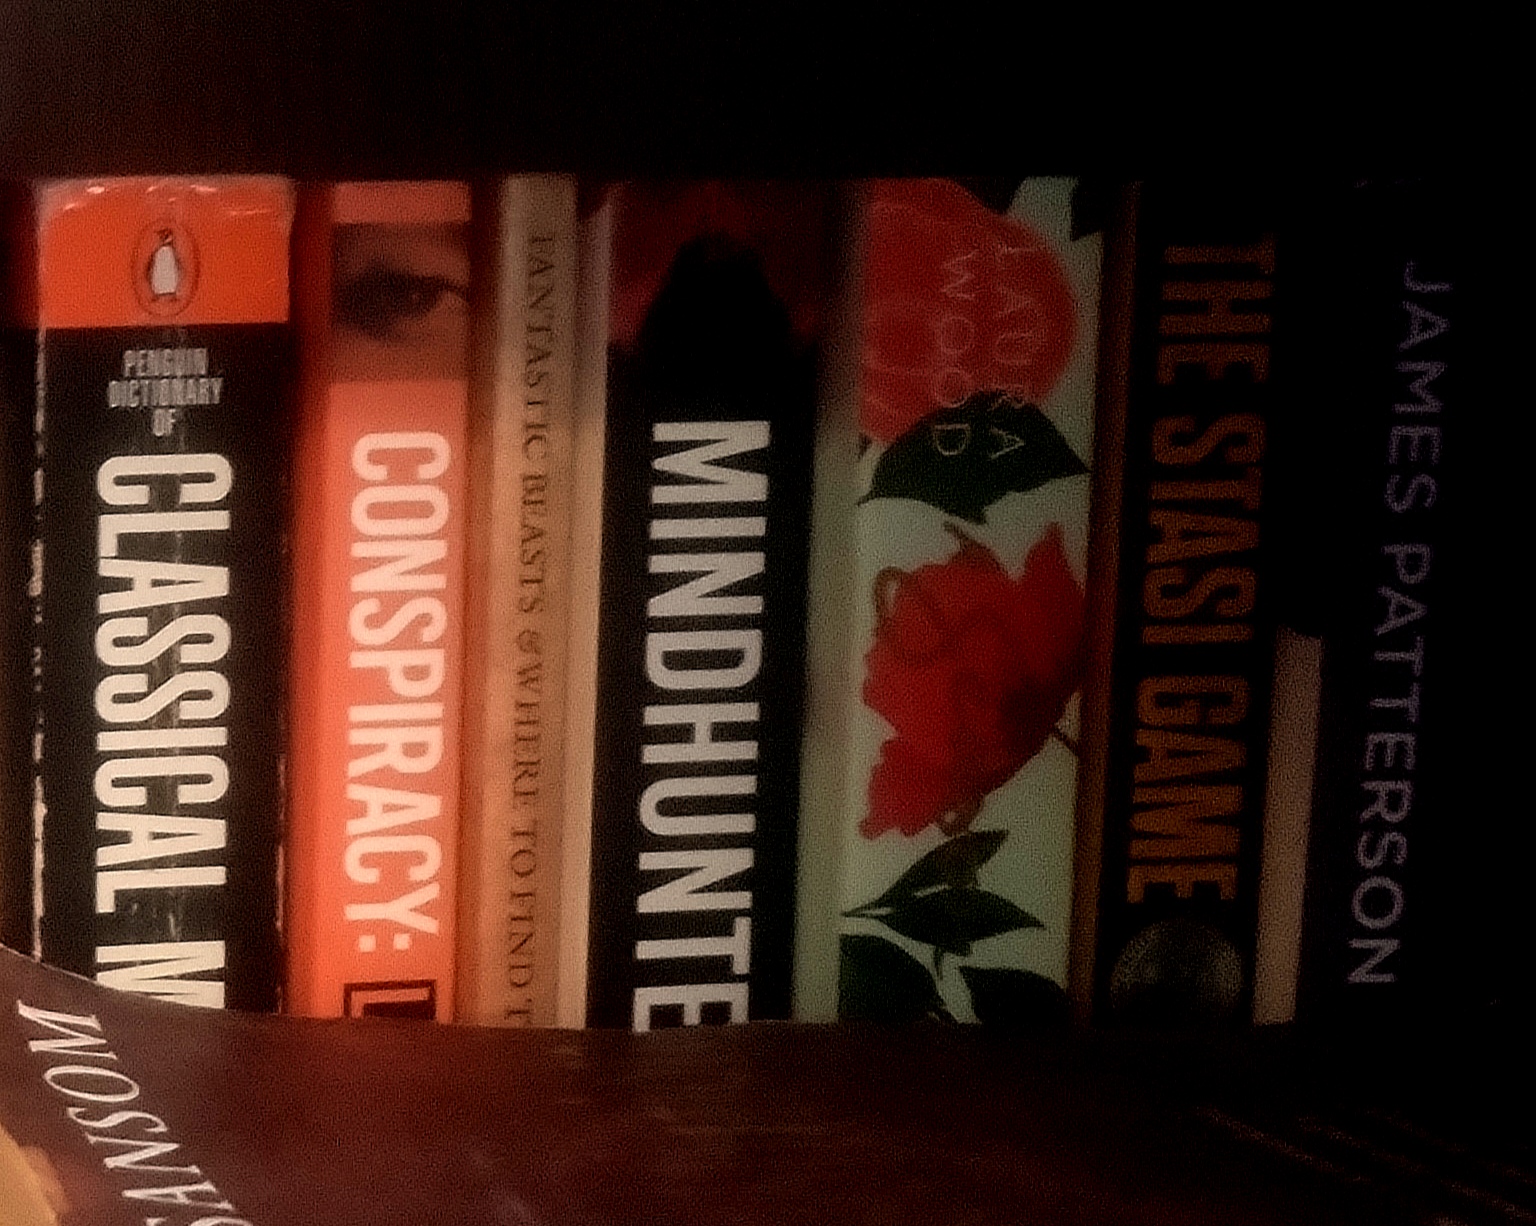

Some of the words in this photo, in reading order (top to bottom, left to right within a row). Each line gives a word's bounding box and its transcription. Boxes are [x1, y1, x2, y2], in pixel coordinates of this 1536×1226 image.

[521, 233, 557, 459] FANTASTIC
[931, 252, 976, 458] WOOD
[987, 245, 1042, 462] LAURA
[1155, 232, 1279, 387] THE
[1384, 258, 1455, 514] JAMES
[518, 474, 549, 615] BEASTS
[1143, 412, 1269, 649] STASI
[94, 452, 234, 914] CLASSICAL
[343, 430, 452, 953] CONSPIRACY:
[510, 660, 540, 808] WHERE
[632, 420, 772, 1032] MINDHUNTE
[1129, 672, 1253, 905] GAME
[1347, 541, 1435, 987] PATTERSON
[508, 890, 536, 989] FIND
[510, 822, 538, 878] TO
